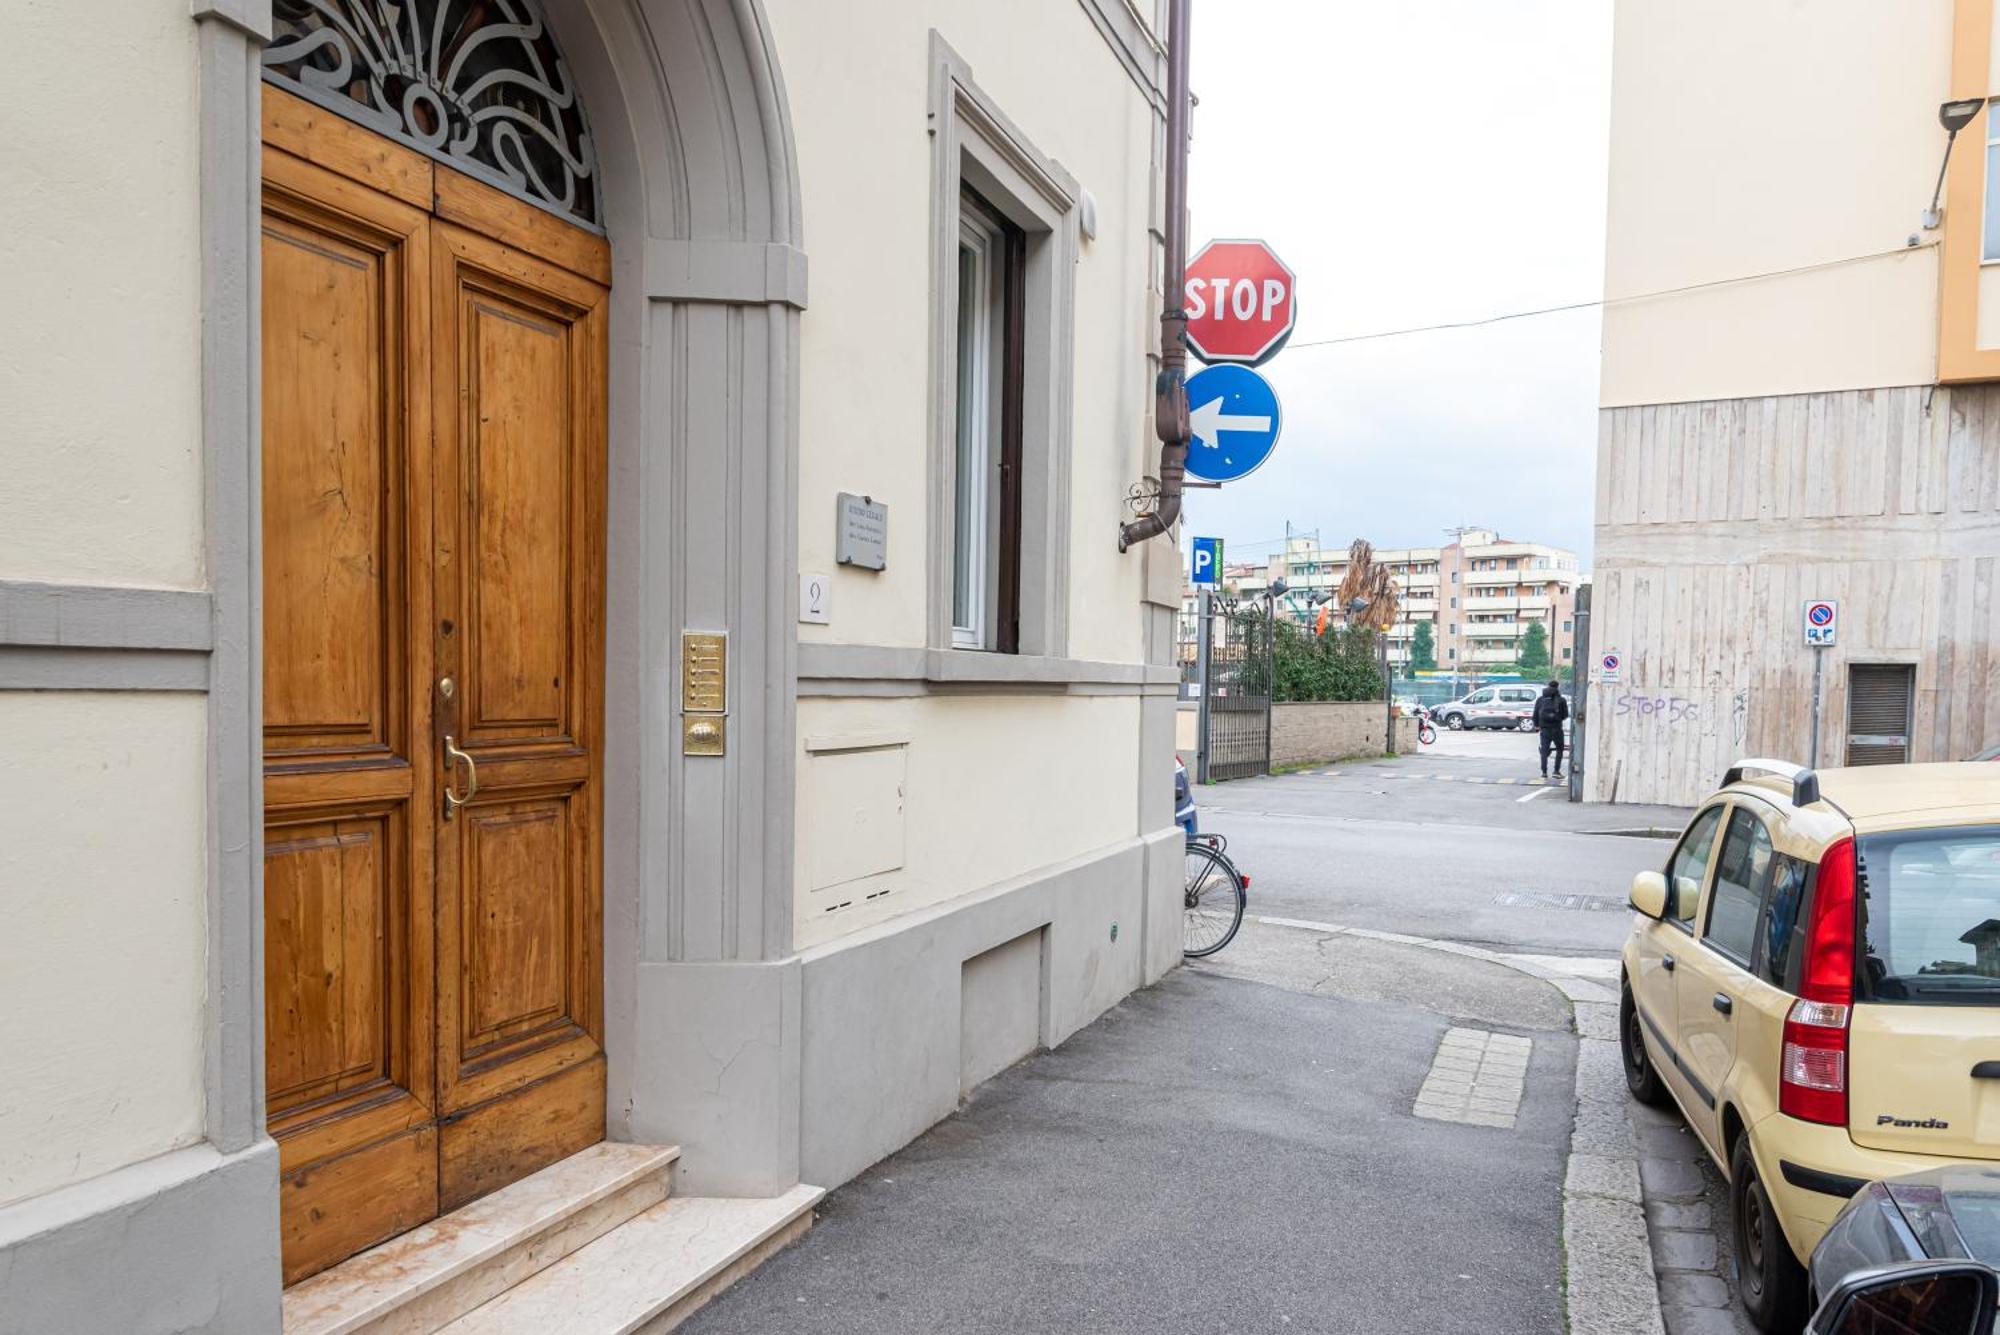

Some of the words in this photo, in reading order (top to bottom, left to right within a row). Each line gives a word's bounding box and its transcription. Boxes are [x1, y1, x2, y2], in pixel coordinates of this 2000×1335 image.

[1185, 278, 1286, 322] STOP
[1195, 549, 1212, 575] P
[809, 581, 821, 614] 2
[1616, 690, 1666, 719] STOP
[1877, 1115, 1949, 1129] Panda
